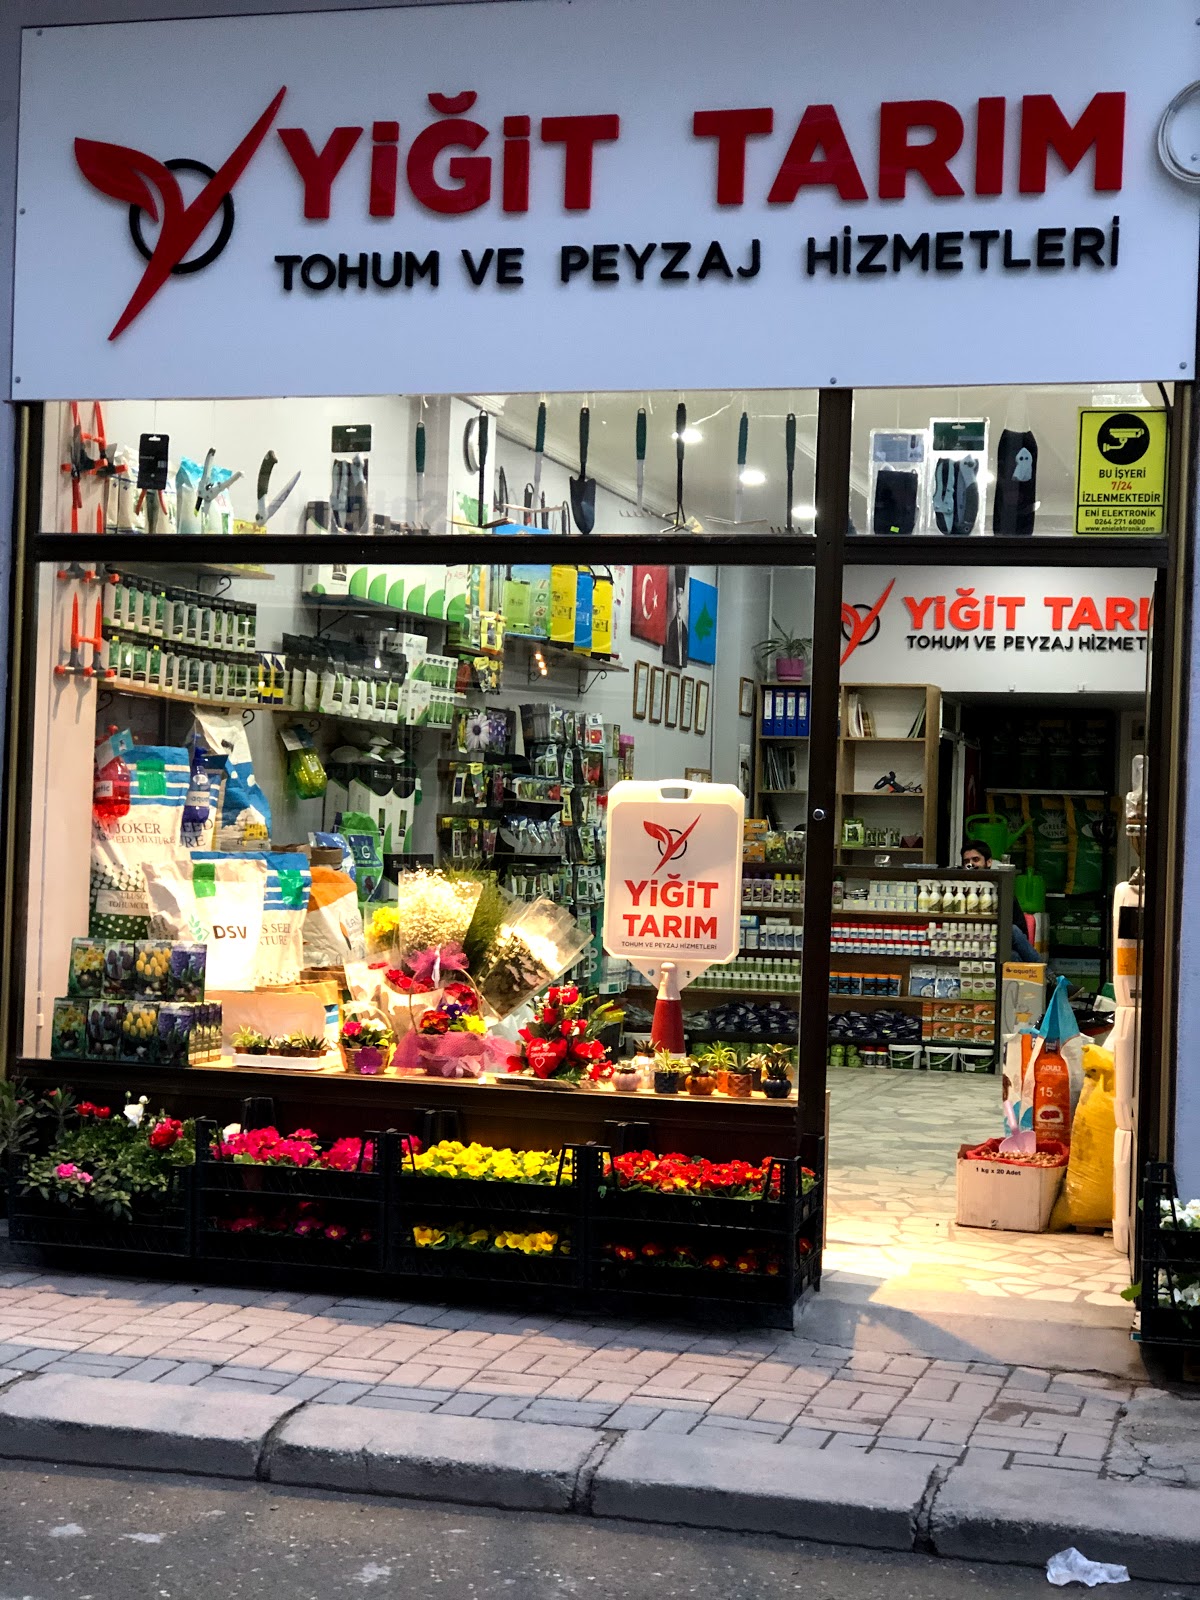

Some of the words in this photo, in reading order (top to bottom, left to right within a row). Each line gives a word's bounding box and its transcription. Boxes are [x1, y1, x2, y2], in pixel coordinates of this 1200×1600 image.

[693, 91, 1127, 206] TARIM
[274, 250, 440, 291] TOHUM
[461, 247, 524, 285] VE
[561, 239, 761, 283] PEYZAJ
[807, 215, 1120, 275] HİZMETLERİ
[1099, 469, 1112, 478] BU
[1115, 467, 1145, 479] İŞYERİ
[1111, 481, 1132, 491] 7/24
[1082, 491, 1161, 503] İZLENMEKTEDİR
[1085, 508, 1100, 517] ENİ
[1102, 508, 1157, 517] ELEKTRONİK
[1095, 518, 1112, 526] 0264
[1114, 518, 1126, 526] 271
[1128, 518, 1146, 526] 6000
[906, 634, 969, 650] TOHUM
[974, 634, 997, 650] VE
[1004, 635, 1074, 651] PEYZAJ
[116, 822, 161, 835] JOKER
[212, 925, 247, 939] DSV
[623, 914, 718, 940] TARIM
[680, 942, 717, 950] HİZMETLERİ
[1039, 1086, 1053, 1098] 15
[981, 1167, 989, 1175] kg
